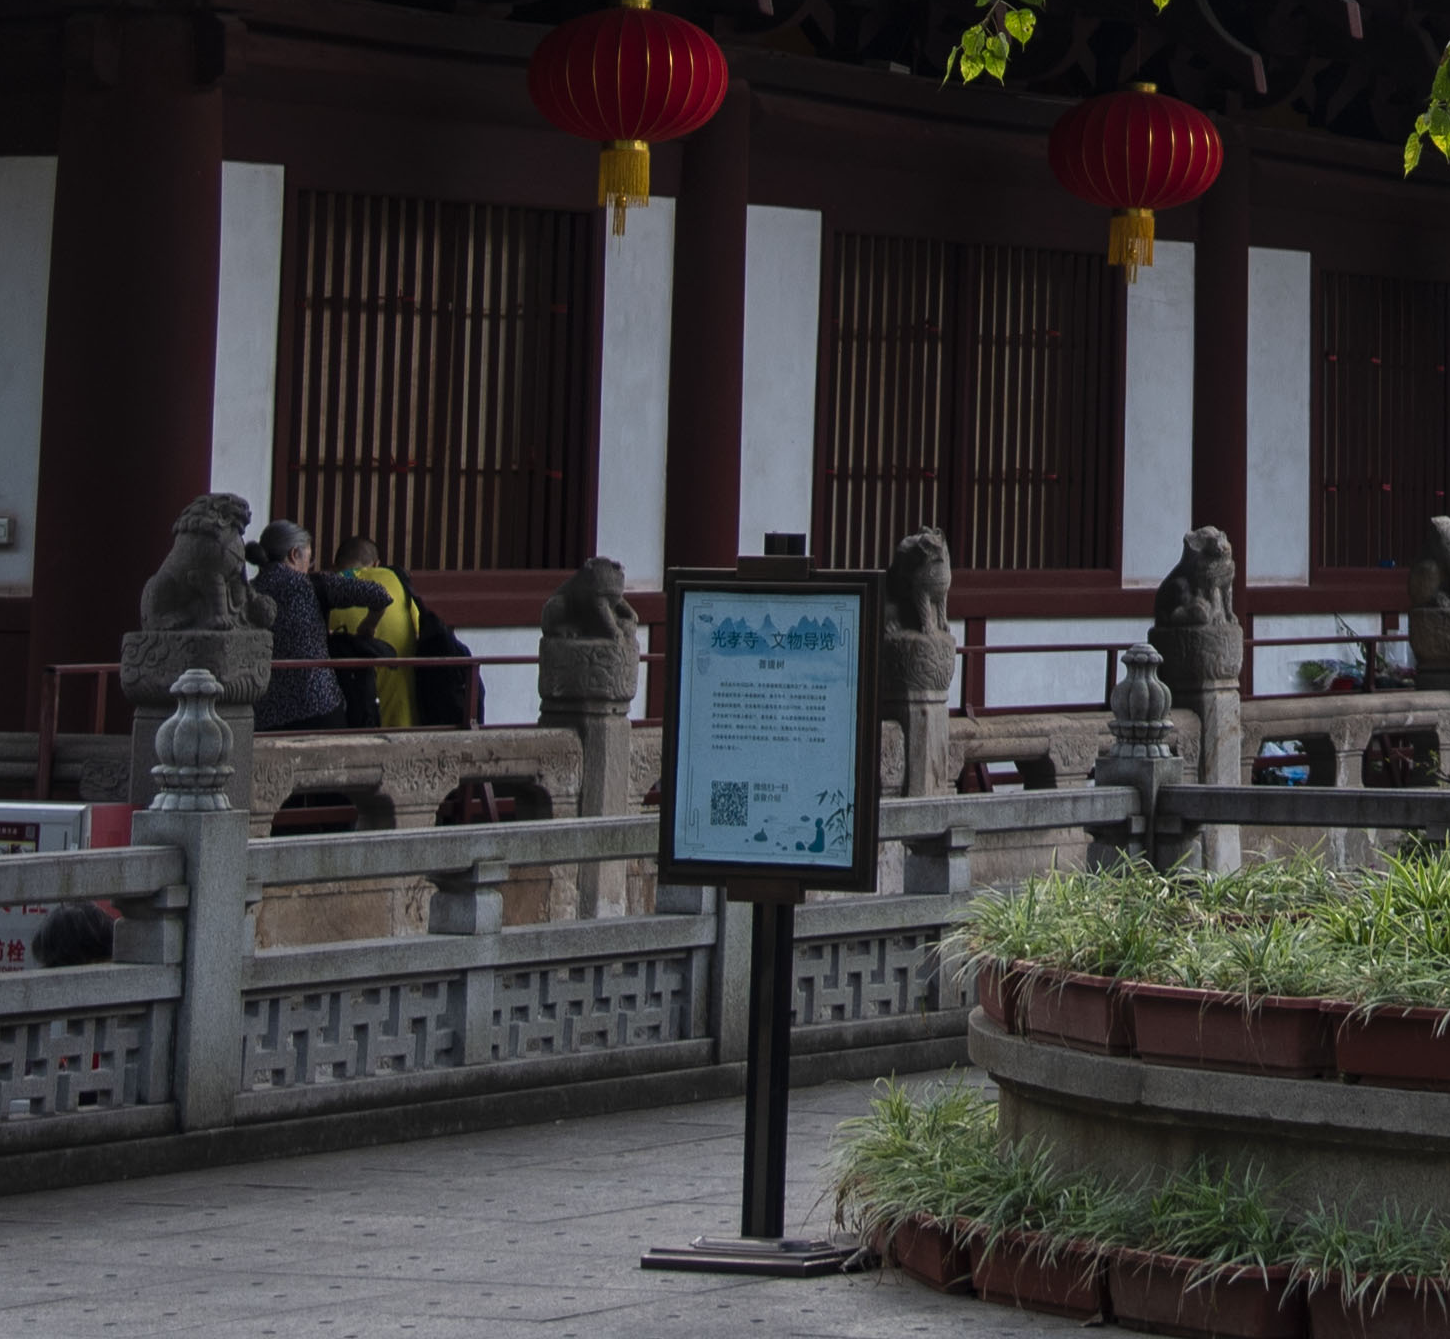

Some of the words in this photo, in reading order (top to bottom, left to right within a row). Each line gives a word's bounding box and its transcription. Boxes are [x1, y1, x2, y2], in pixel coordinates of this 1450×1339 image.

[711, 630, 759, 649] 光孝寺
[771, 632, 835, 651] 文物导览
